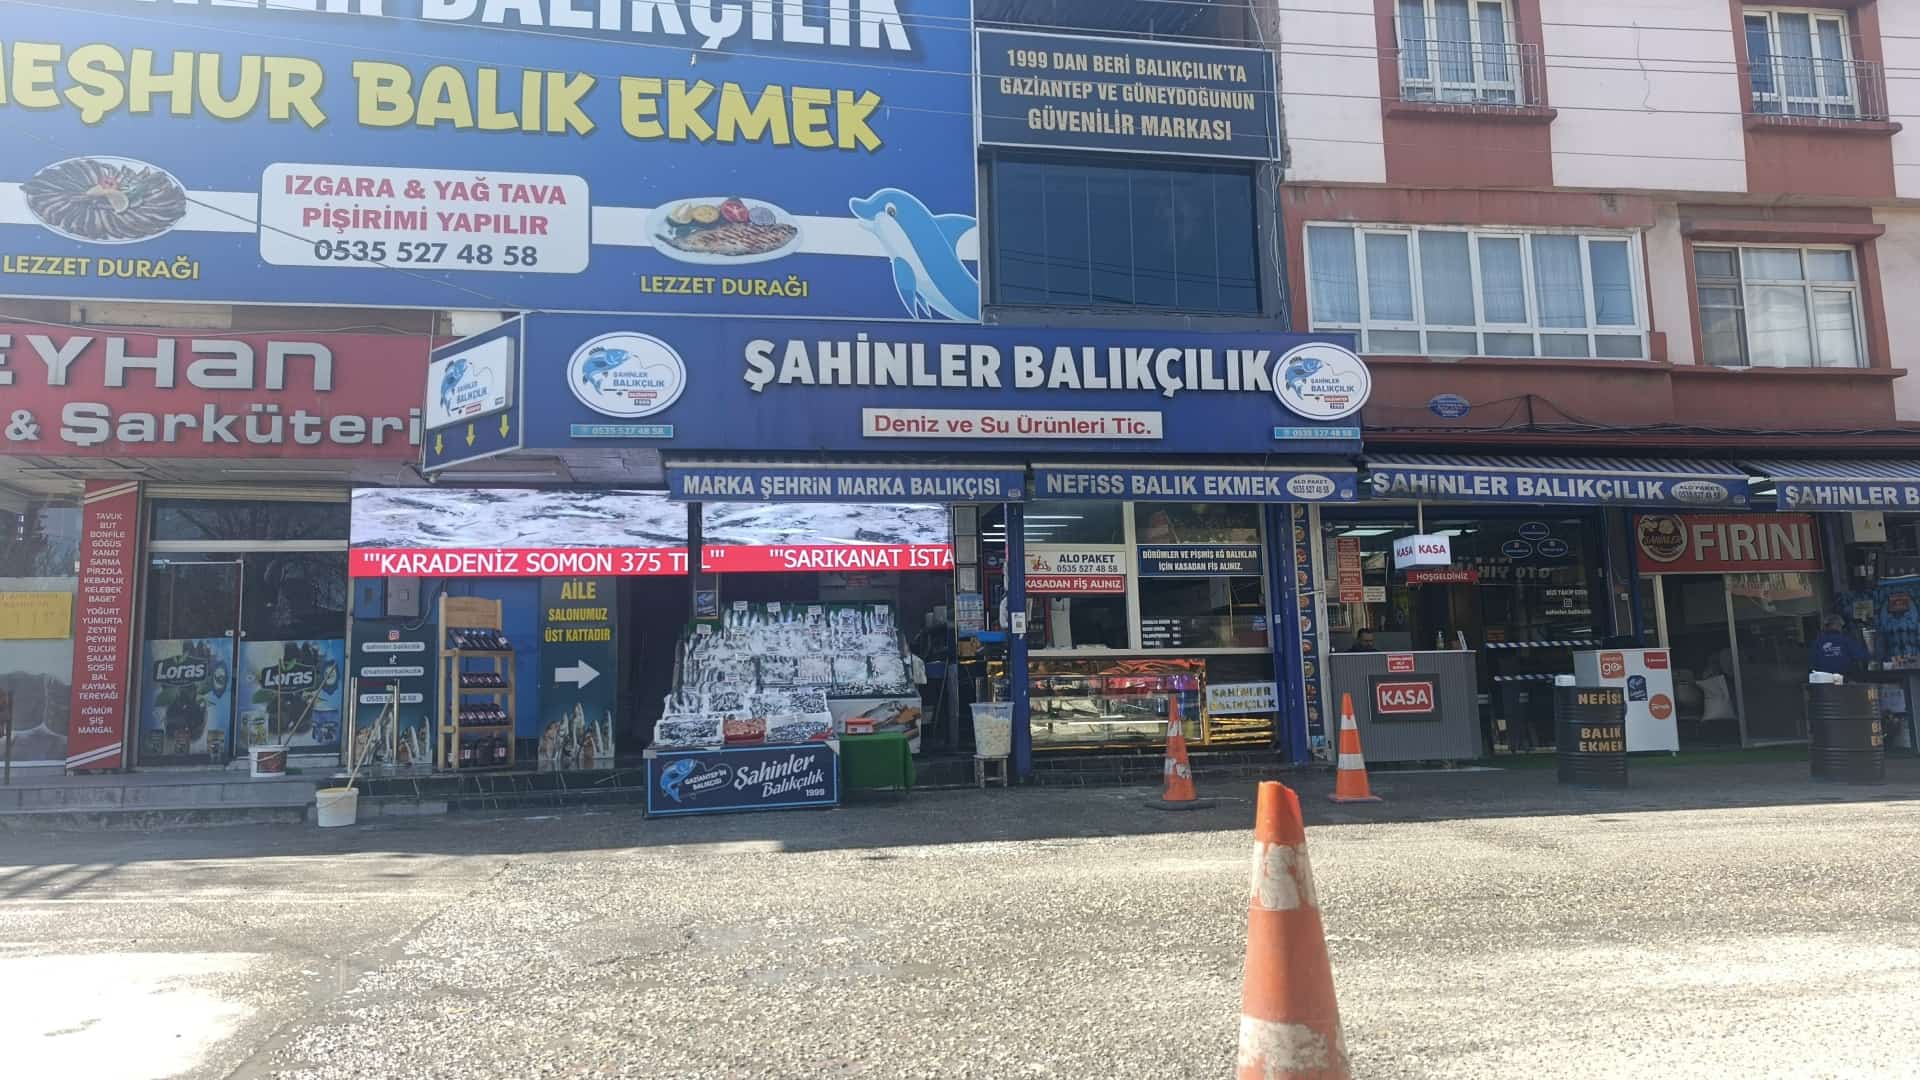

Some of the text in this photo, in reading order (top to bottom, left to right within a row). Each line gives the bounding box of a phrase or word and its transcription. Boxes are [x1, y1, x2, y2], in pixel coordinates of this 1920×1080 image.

[1008, 50, 1248, 83] 1999 DAN BERİ BALIKÇILIK'TA
[0, 41, 883, 152] EŞHUR BALIK EKMEK
[1000, 76, 1255, 111] GAZİANTEP VE GÜNEYDOĞUNUN
[1028, 106, 1232, 141] GÜVENİLİR MARKASI
[284, 174, 567, 206] IZGARA & YAĞ TAVA
[302, 204, 548, 236] PİŞİRİMİ YAPILIR
[313, 240, 539, 267] 0535 527 48 58
[3, 255, 200, 281] LEZZET DURAĞI
[641, 275, 808, 298] LEZZET DURAĞI
[0, 334, 333, 392] YHan
[743, 332, 1274, 398] ŞAHİNLER BALIKÇILIK
[5, 401, 421, 448] & Şarküteri
[874, 414, 1151, 435] Deniz ve Su Ürünleri Tic.
[683, 475, 755, 495] MARKA
[838, 478, 905, 496] MARKA
[910, 477, 1000, 500] BALIKÇISI
[1131, 475, 1197, 495] BALIK
[1204, 476, 1280, 496] EKMEK
[1517, 479, 1664, 501] BALIKÇILIK
[1397, 547, 1413, 557] KASA
[1419, 544, 1446, 554] KASA
[1692, 523, 1815, 561] FIRINI
[526, 553, 612, 573] SOMON
[621, 553, 661, 573] 375
[1057, 564, 1119, 573] 0535 527 48 58
[1059, 554, 1115, 563] ALO PAKET
[1175, 561, 1206, 571] KASADAN
[1208, 561, 1218, 572] FİŞ
[87, 567, 122, 575] PİRZOLA
[1417, 571, 1468, 581] HOŞGELDİNİZ
[561, 578, 597, 599] AİLE
[1025, 578, 1120, 590] KASADAN FİŞ ALINIZ
[86, 606, 120, 615] YOĞURT
[548, 608, 608, 621] SALONUMUZ
[82, 617, 122, 625] YUMURTA
[545, 627, 611, 642] ÜST KATTADIR
[88, 645, 116, 653] SUCUK
[91, 673, 108, 681] BAL
[156, 661, 205, 680] Loras
[264, 669, 313, 687] Loras
[80, 692, 119, 700] TEREYAĞI
[1381, 689, 1429, 706] KASA
[81, 706, 112, 714] KÖMÜR
[734, 754, 815, 790] Şahinler
[762, 770, 825, 798] Balıkçılık
[806, 789, 825, 798] 1999
